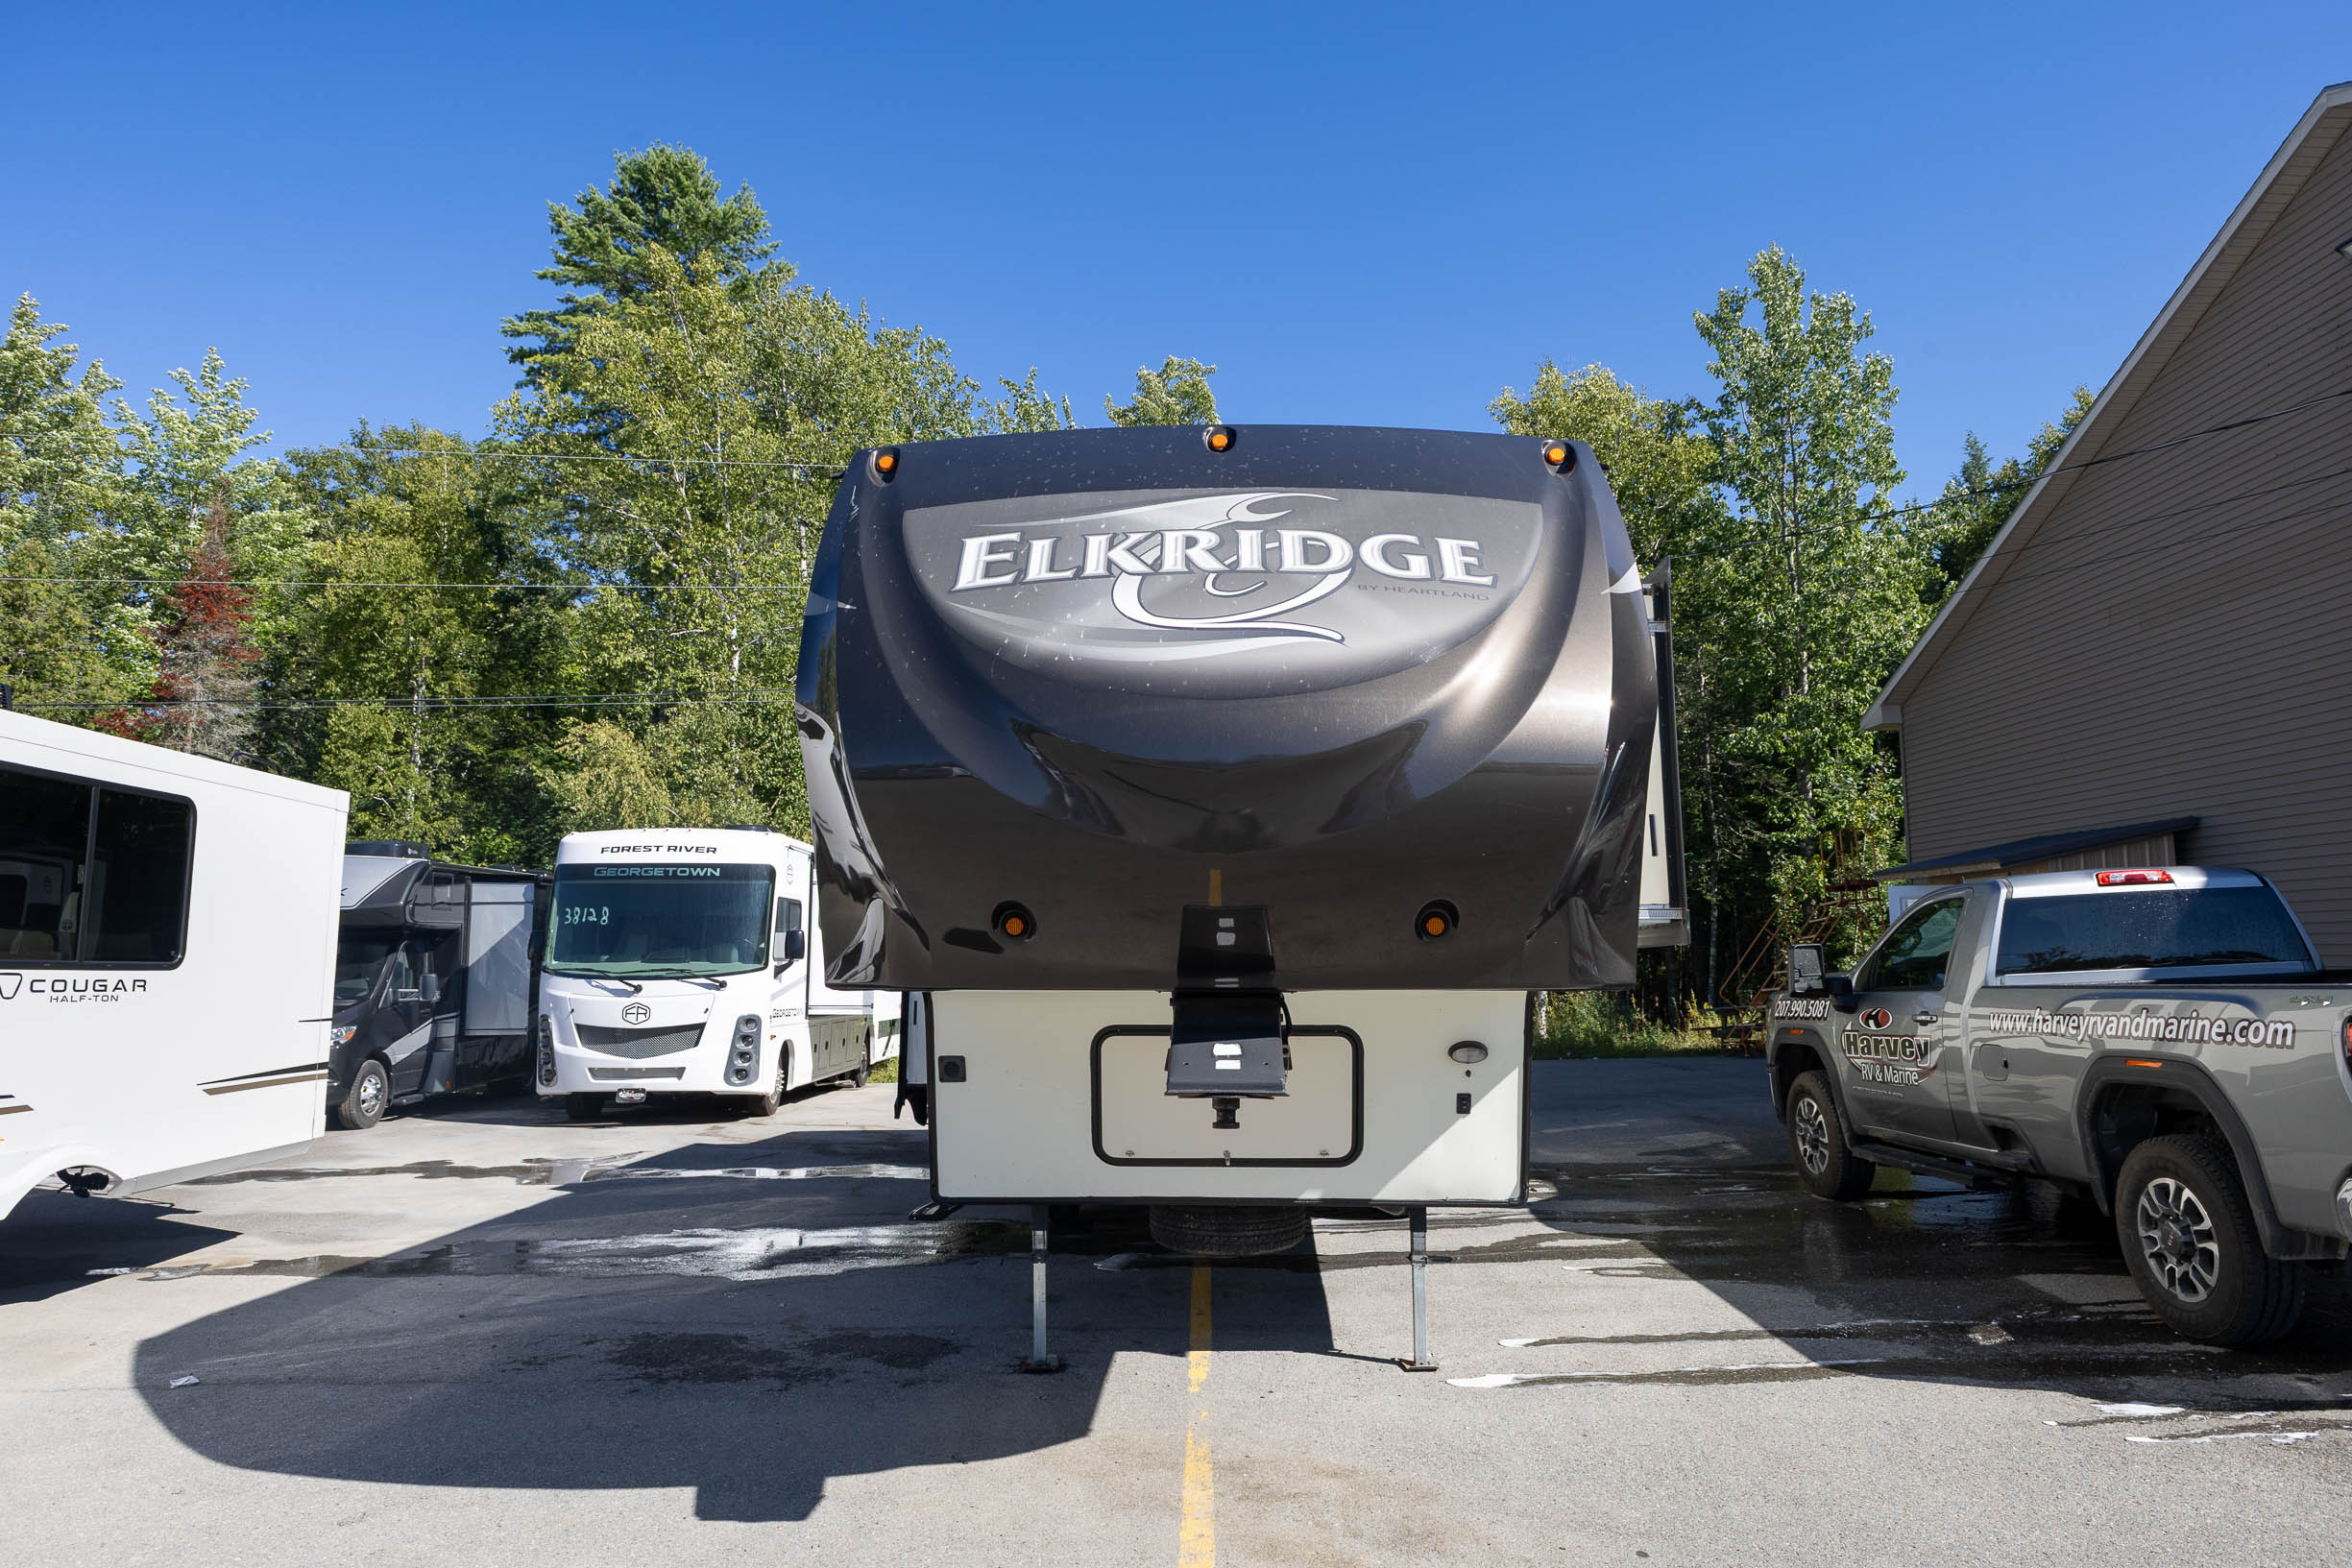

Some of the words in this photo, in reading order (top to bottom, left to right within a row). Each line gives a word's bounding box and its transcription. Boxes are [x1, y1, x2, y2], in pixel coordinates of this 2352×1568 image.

[950, 528, 1499, 592] ELKRIDGE
[1384, 586, 1490, 601] HEARTLAND
[600, 845, 664, 855] FOREST
[667, 845, 717, 855] RIVER
[594, 867, 720, 877] GEORGETOWN
[563, 906, 610, 926] 38128
[30, 978, 147, 993] COUGAR
[1774, 999, 1831, 1021] 207.990.5081
[1988, 1007, 2296, 1049] www.harveyrvandmarine.com
[1843, 1030, 1932, 1068] Harvey
[1861, 1063, 1874, 1081] RV
[1875, 1066, 1883, 1082] &
[1884, 1064, 1919, 1085] Marine
